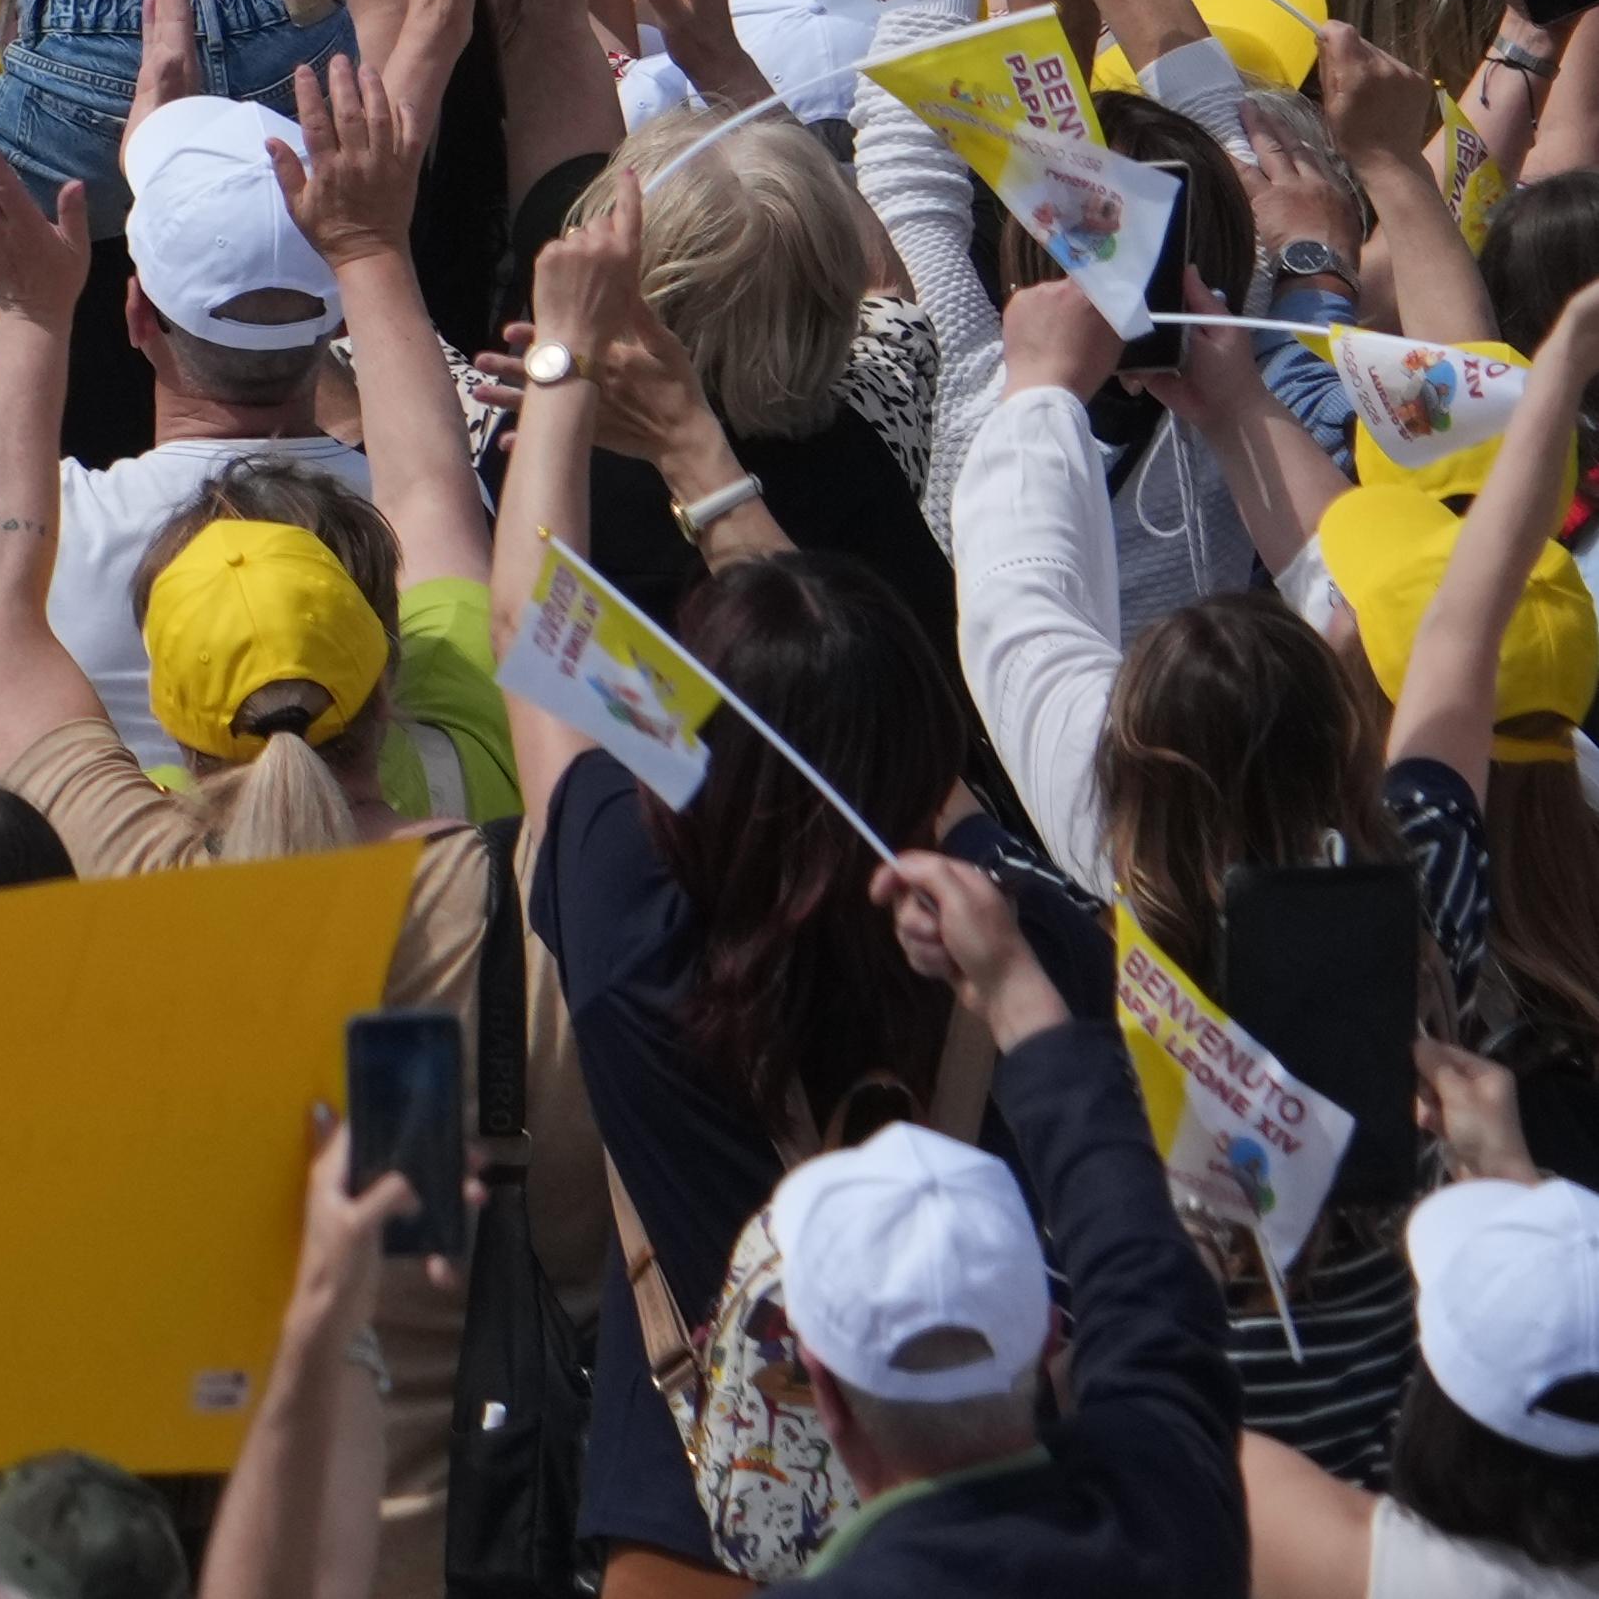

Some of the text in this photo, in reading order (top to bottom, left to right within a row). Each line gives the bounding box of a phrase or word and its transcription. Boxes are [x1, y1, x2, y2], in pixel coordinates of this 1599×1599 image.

[1123, 947, 1306, 1125] BENVENUTO
[1166, 1035, 1250, 1119] LEONE
[1255, 1114, 1304, 1156] XIV
